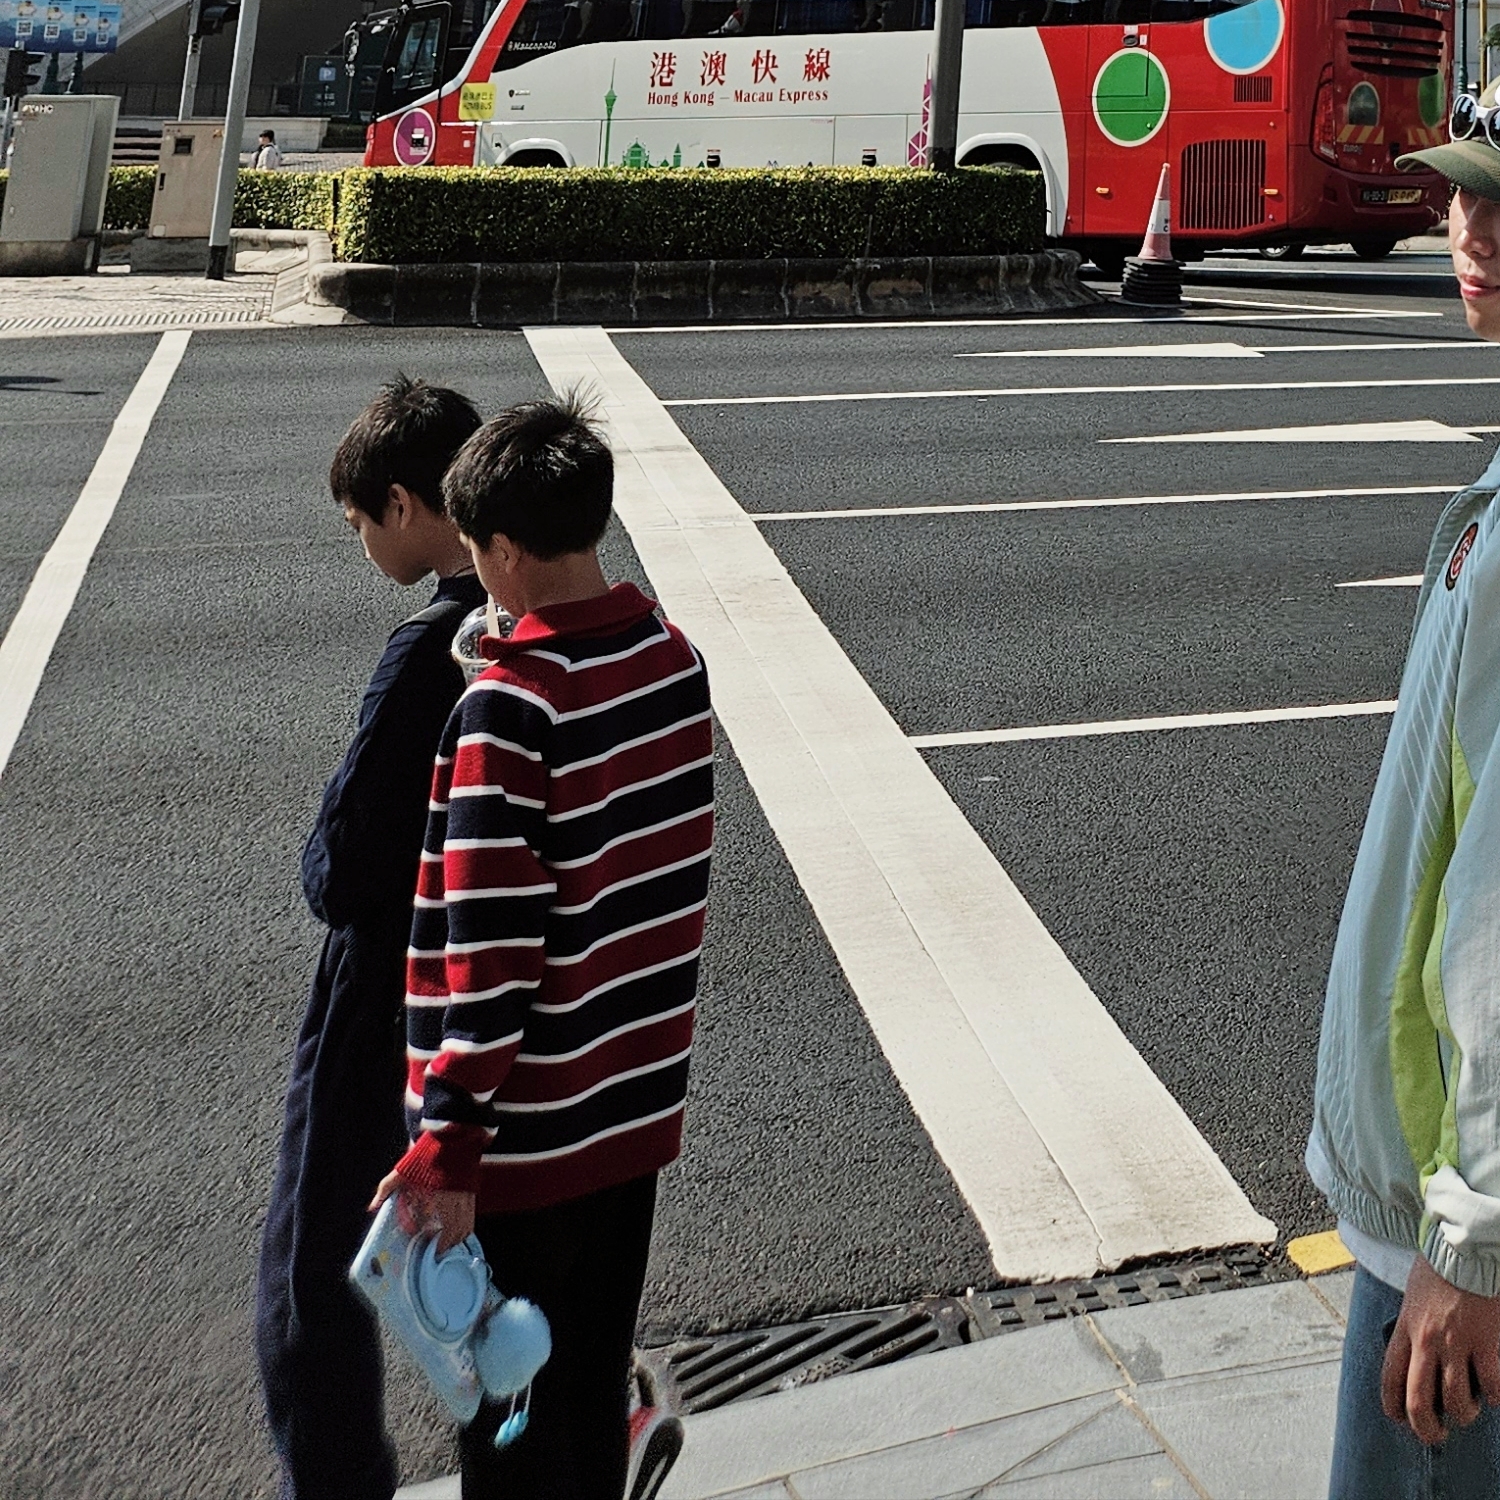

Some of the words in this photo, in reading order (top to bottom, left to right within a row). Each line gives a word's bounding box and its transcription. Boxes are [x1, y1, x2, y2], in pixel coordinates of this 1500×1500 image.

[649, 47, 832, 88] 港澳快線
[648, 91, 679, 107] Hong
[683, 90, 715, 106] Kong
[733, 89, 773, 103] Macau
[778, 87, 829, 105] Express
